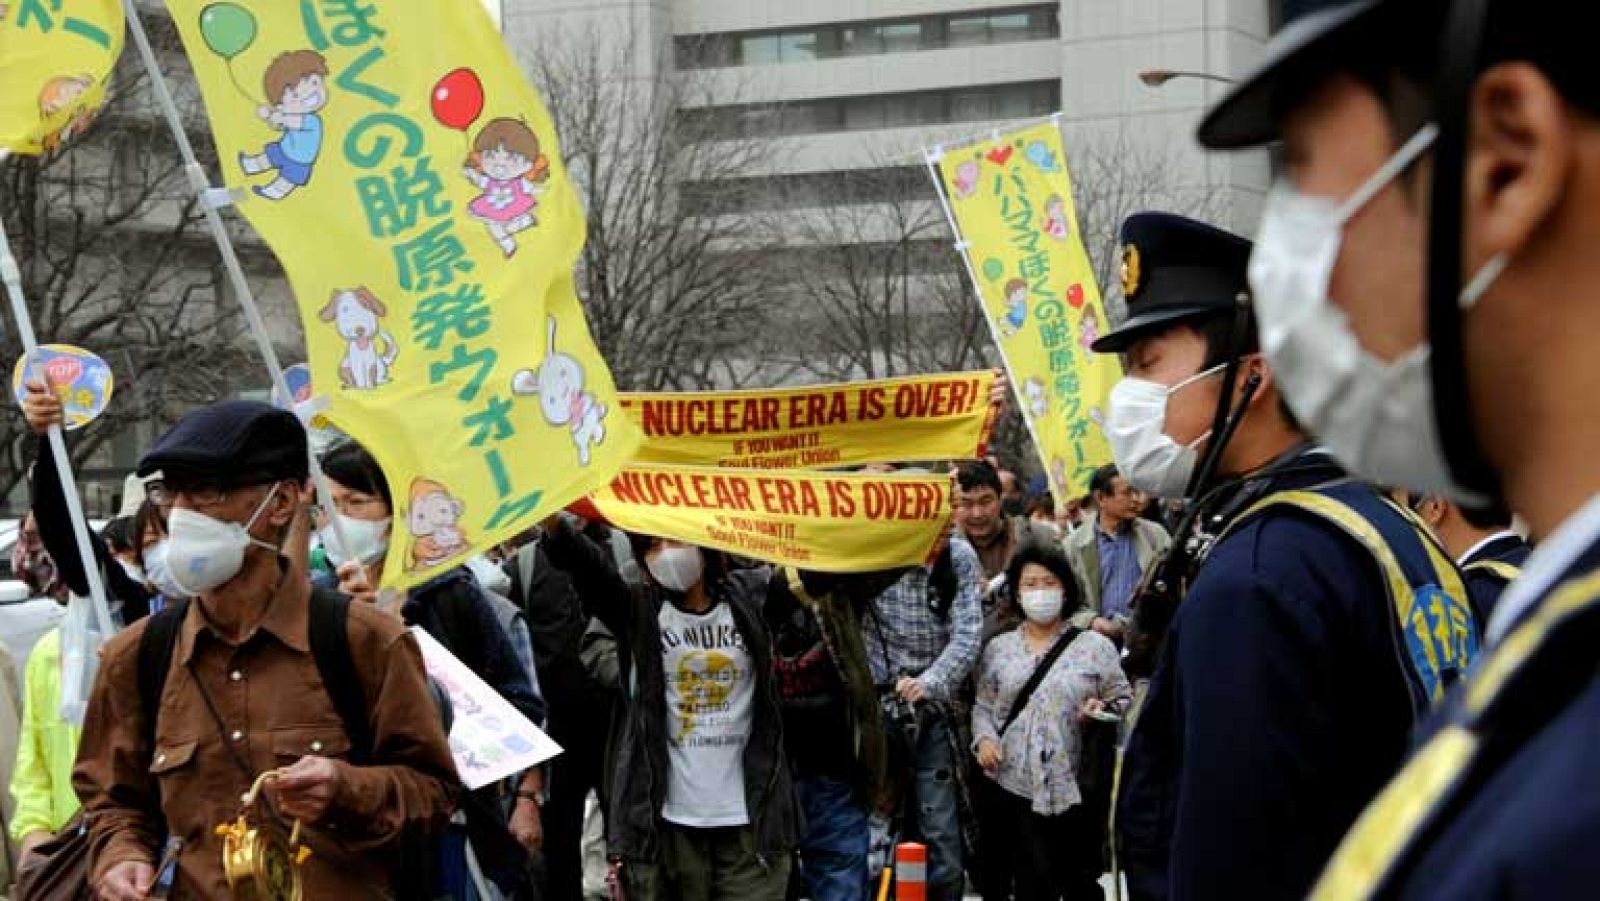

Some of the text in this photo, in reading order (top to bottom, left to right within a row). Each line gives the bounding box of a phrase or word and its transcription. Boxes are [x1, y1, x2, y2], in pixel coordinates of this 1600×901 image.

[642, 380, 979, 436] NUCLEAR ERA IS OVER!
[748, 438, 770, 453] YOU
[773, 435, 804, 451] WANT
[807, 432, 820, 447] IT
[802, 449, 840, 464] Union
[610, 470, 943, 521] NUCLEAR ERA IS OVER!
